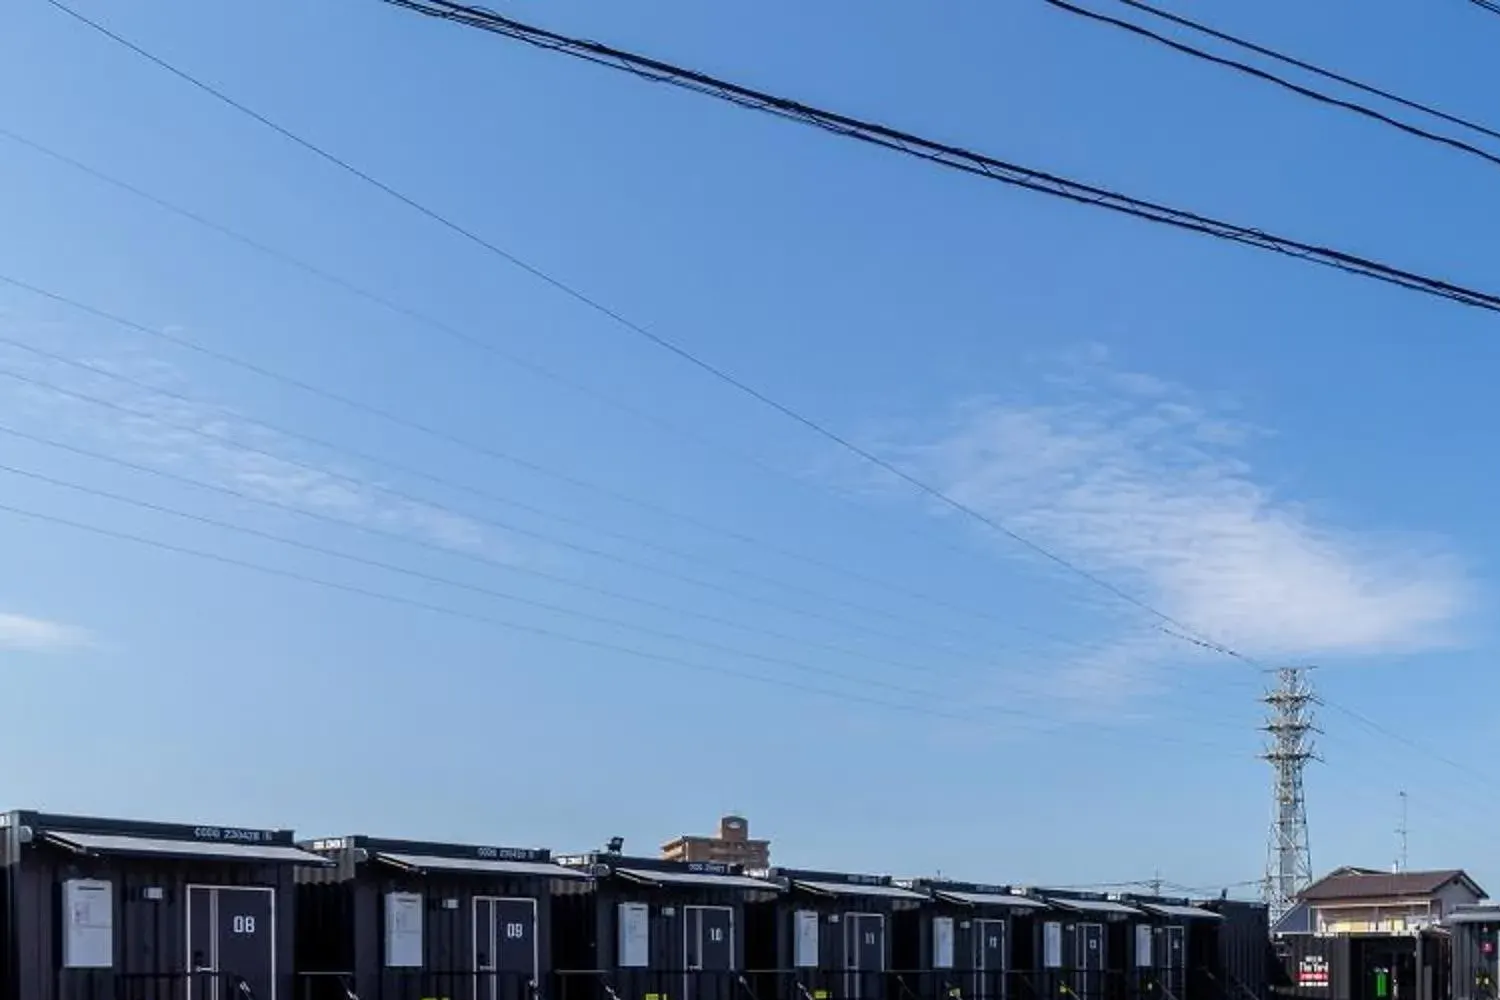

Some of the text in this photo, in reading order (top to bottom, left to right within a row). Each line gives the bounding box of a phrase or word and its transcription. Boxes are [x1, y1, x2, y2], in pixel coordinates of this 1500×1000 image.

[233, 915, 255, 933] 08
[507, 923, 523, 938] 09
[710, 927, 723, 941] 10
